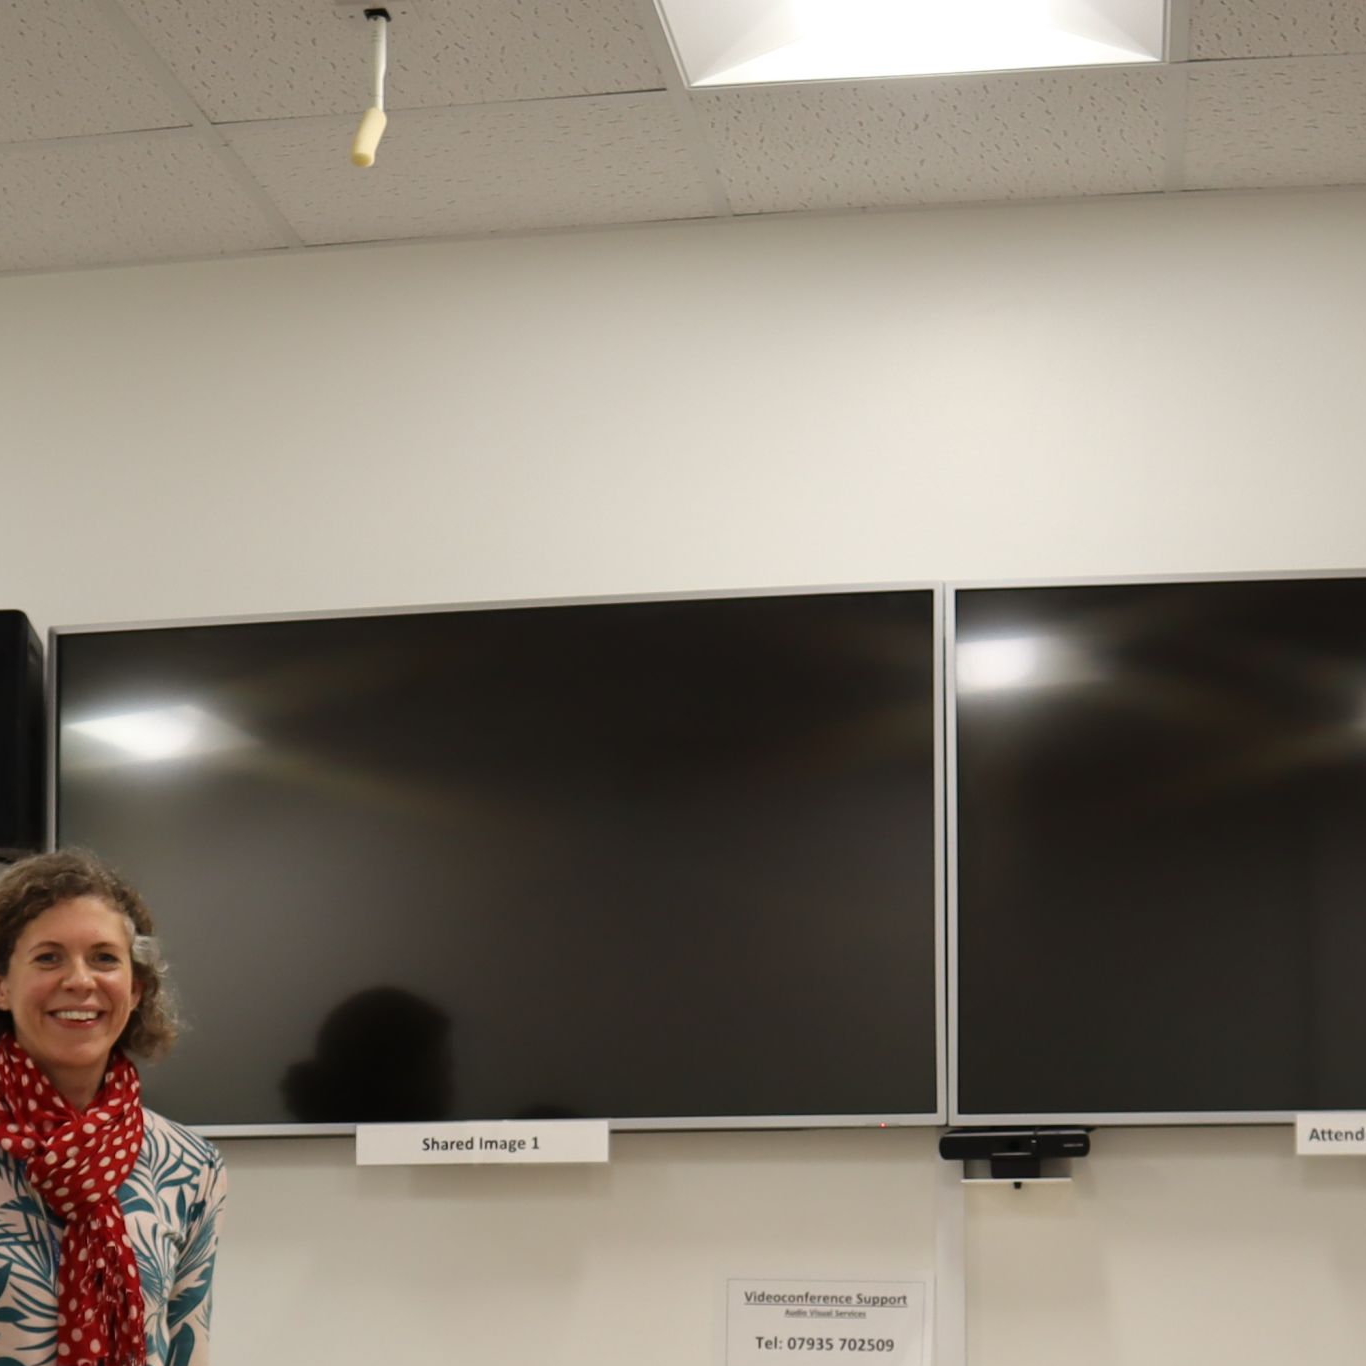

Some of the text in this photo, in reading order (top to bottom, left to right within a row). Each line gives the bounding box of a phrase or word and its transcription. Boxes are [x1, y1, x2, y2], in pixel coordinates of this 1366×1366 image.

[422, 1136, 540, 1153] Shared Image 1
[744, 1291, 908, 1307] Videoconference Support
[784, 1309, 867, 1318] Audio Visual Services
[755, 1336, 895, 1352] Tel: 07935 702509
